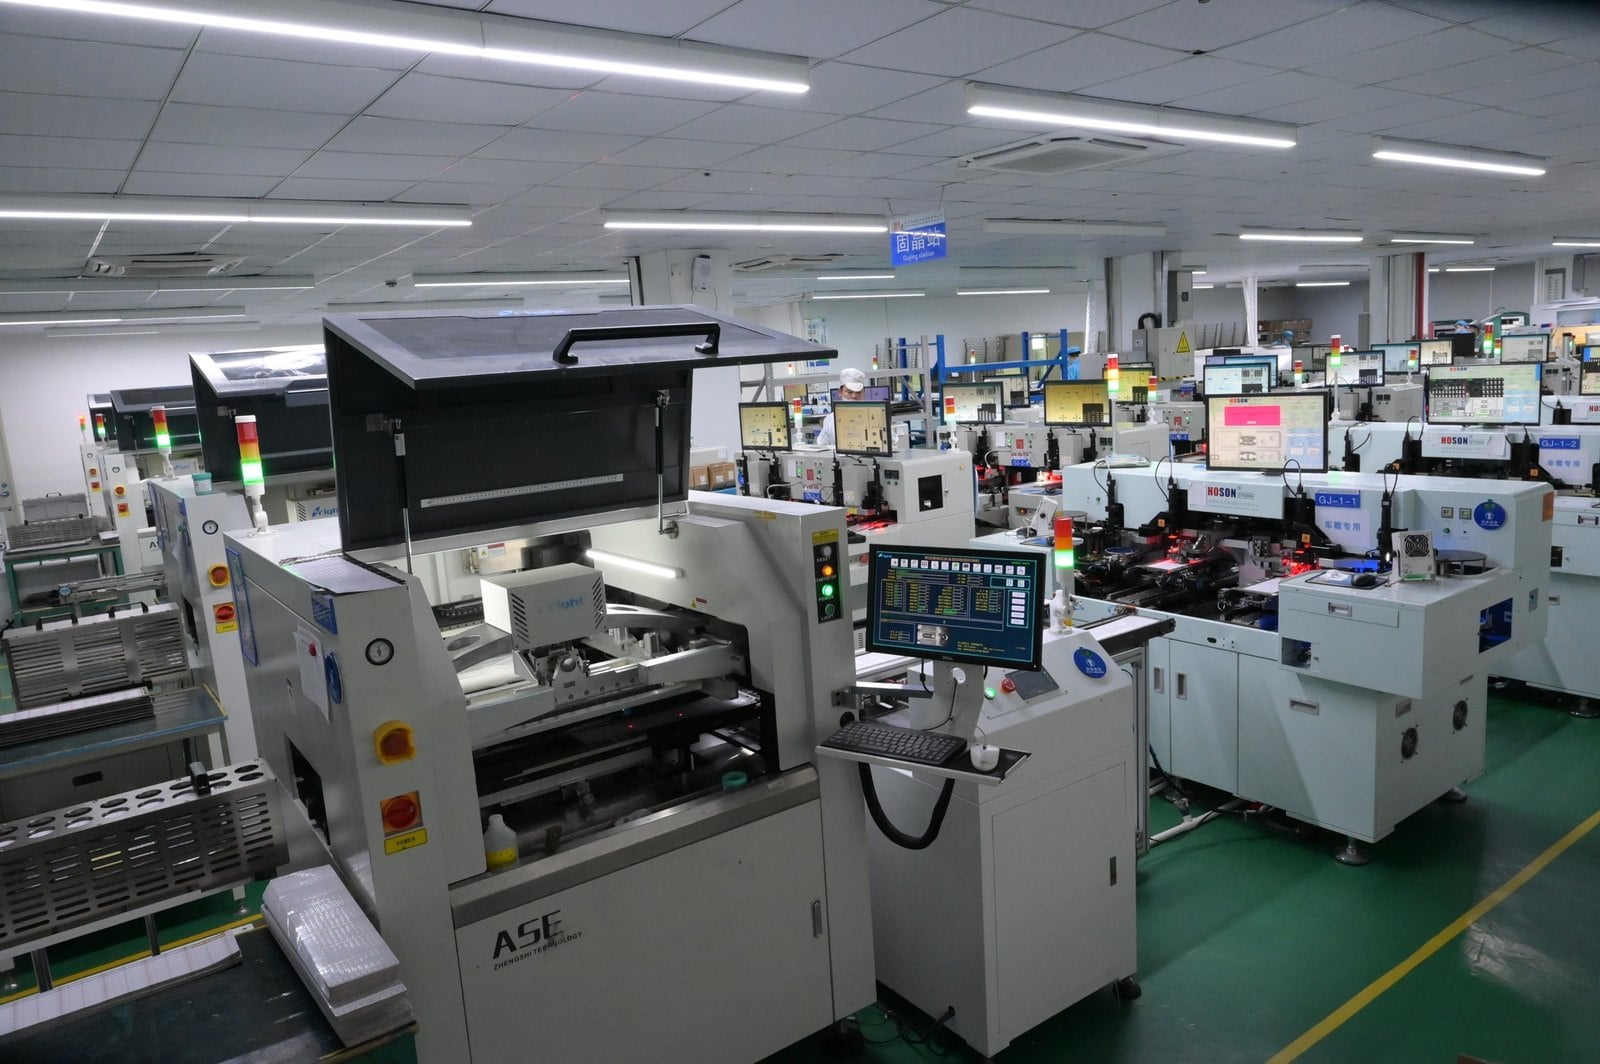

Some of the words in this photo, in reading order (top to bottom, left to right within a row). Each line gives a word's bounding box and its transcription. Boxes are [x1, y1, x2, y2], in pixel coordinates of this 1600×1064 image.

[896, 226, 941, 254] 固晶站
[918, 250, 935, 258] station
[1441, 436, 1468, 445] HOSON
[1541, 440, 1577, 448] GJ-1-2
[1207, 486, 1237, 498] HOSON
[1318, 495, 1356, 506] GJ-1-1
[1325, 520, 1361, 532] 车载专用
[492, 909, 563, 959] ASE
[493, 951, 532, 971] ZHENGSHI
[533, 931, 583, 955] TECHNOLOGY
